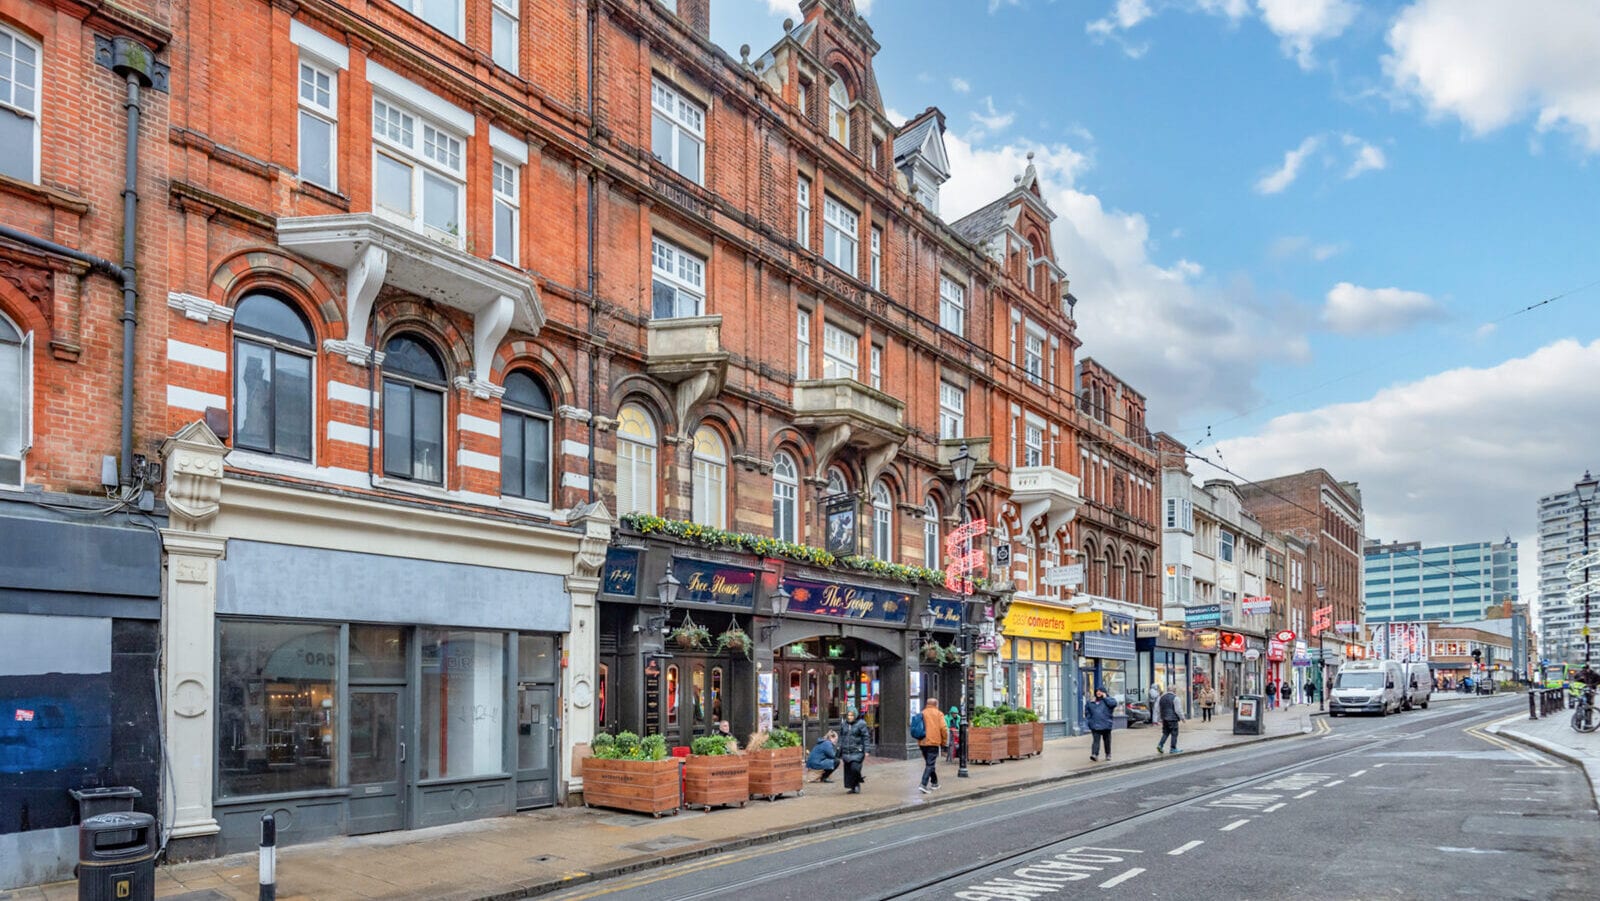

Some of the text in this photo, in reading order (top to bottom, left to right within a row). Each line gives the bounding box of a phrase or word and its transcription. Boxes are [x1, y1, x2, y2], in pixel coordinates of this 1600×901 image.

[688, 572, 739, 597] Free House
[820, 585, 874, 618] The George
[1028, 616, 1065, 630] converters
[1102, 614, 1131, 637] USH
[1138, 625, 1159, 633] RUSH
[1127, 688, 1145, 697] USH
[954, 847, 1144, 901] LOADING
